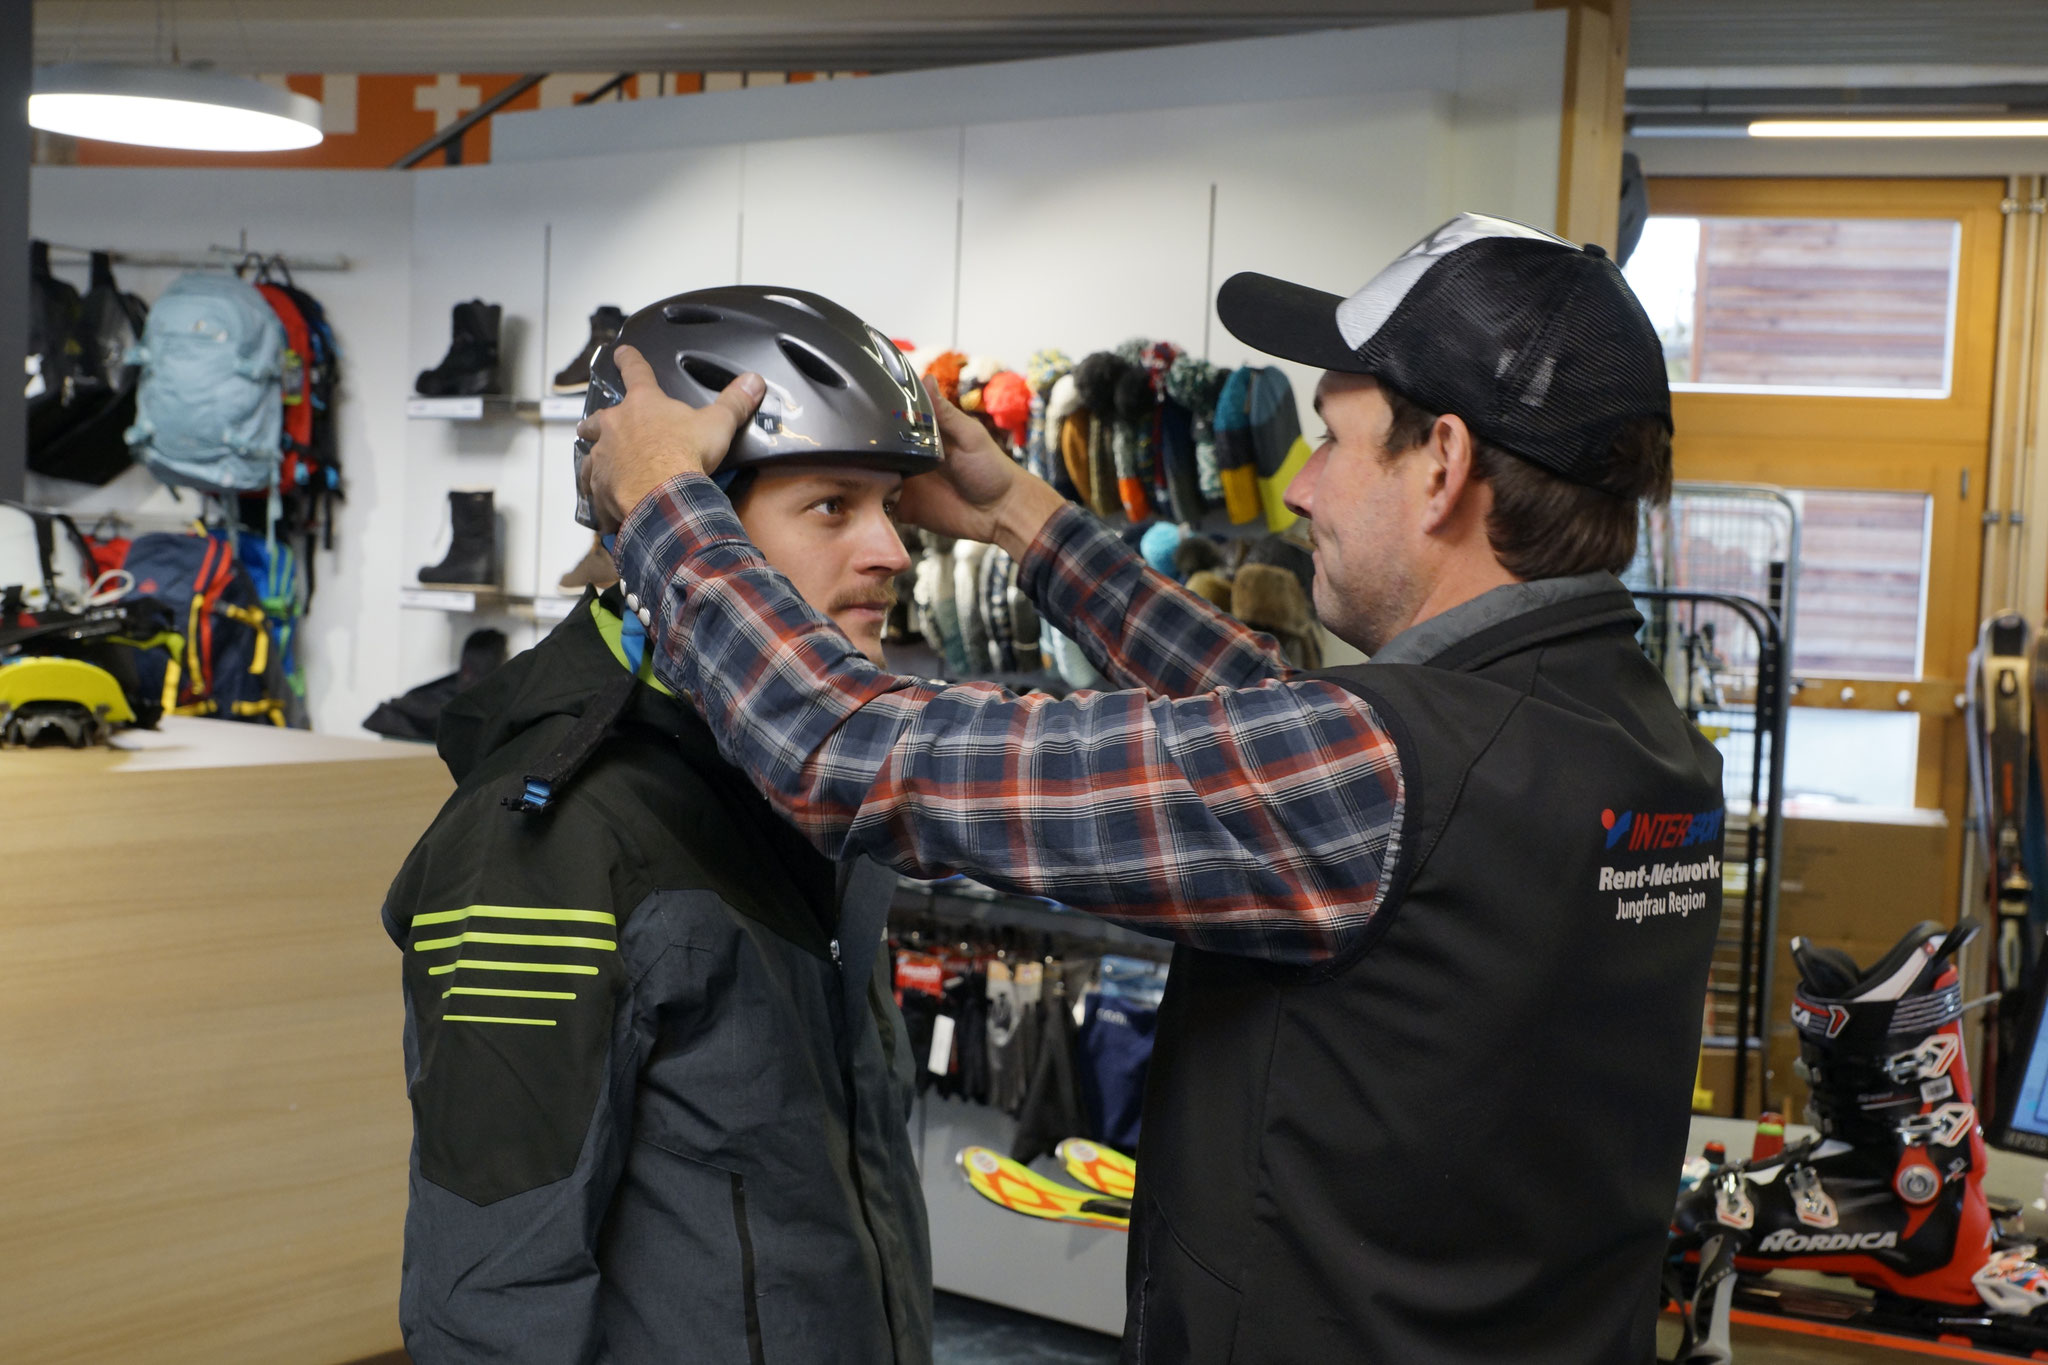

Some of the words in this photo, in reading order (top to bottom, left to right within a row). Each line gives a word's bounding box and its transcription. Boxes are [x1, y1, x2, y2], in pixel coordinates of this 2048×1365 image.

[764, 418, 774, 431] M
[1598, 854, 1721, 891] Rent-Network
[1616, 892, 1666, 924] Jungfrau
[1668, 888, 1706, 918] Region
[1758, 1228, 1898, 1252] NORDICA
